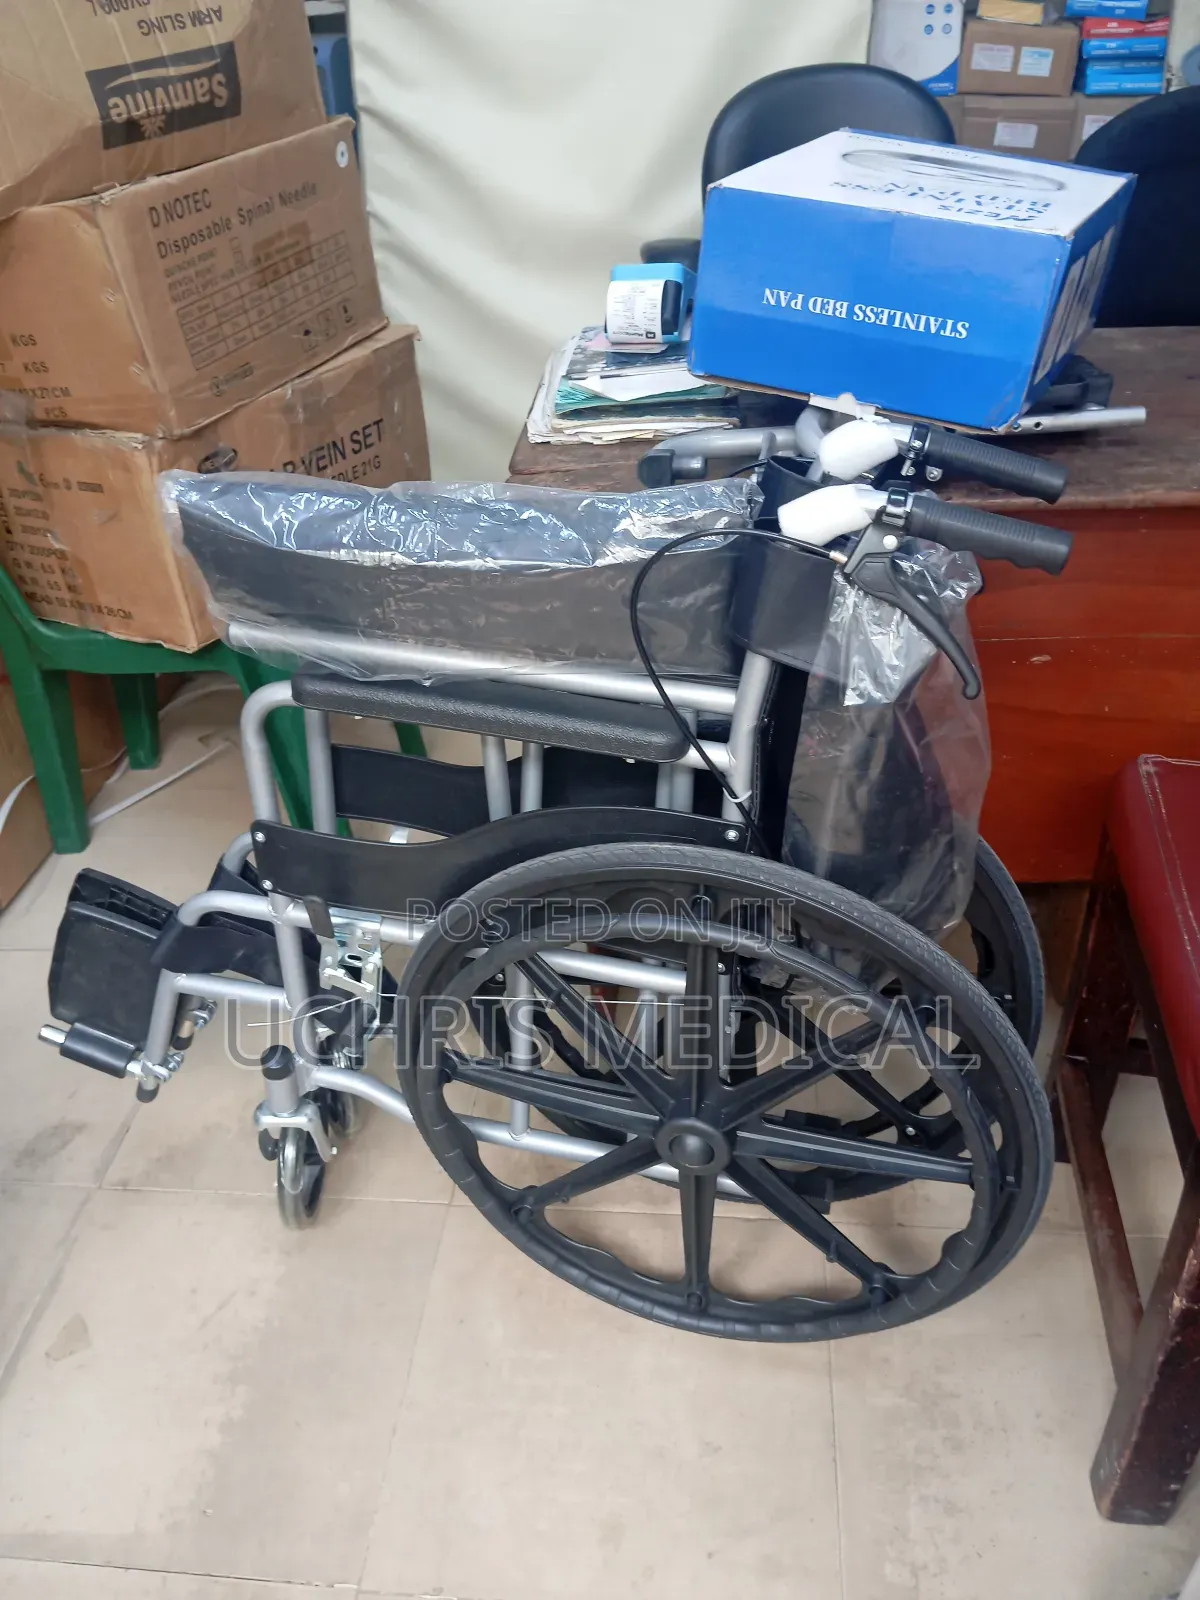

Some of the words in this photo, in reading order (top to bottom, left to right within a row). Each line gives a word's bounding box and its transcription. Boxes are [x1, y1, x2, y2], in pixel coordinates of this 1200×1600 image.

[137, 13, 187, 36] SLING
[188, 5, 223, 27] ARM
[107, 73, 228, 123] Samvine
[163, 188, 212, 224] NOTEC
[156, 216, 232, 260] Disposable
[237, 196, 275, 227] Spinal
[278, 181, 318, 207] Needle
[762, 287, 805, 311] PAN
[808, 295, 849, 319] BED
[853, 303, 970, 339] STAINLESS
[10, 332, 37, 347] KGS
[22, 361, 49, 373] KGS
[300, 437, 347, 476] VEIN
[350, 418, 384, 455] SET
